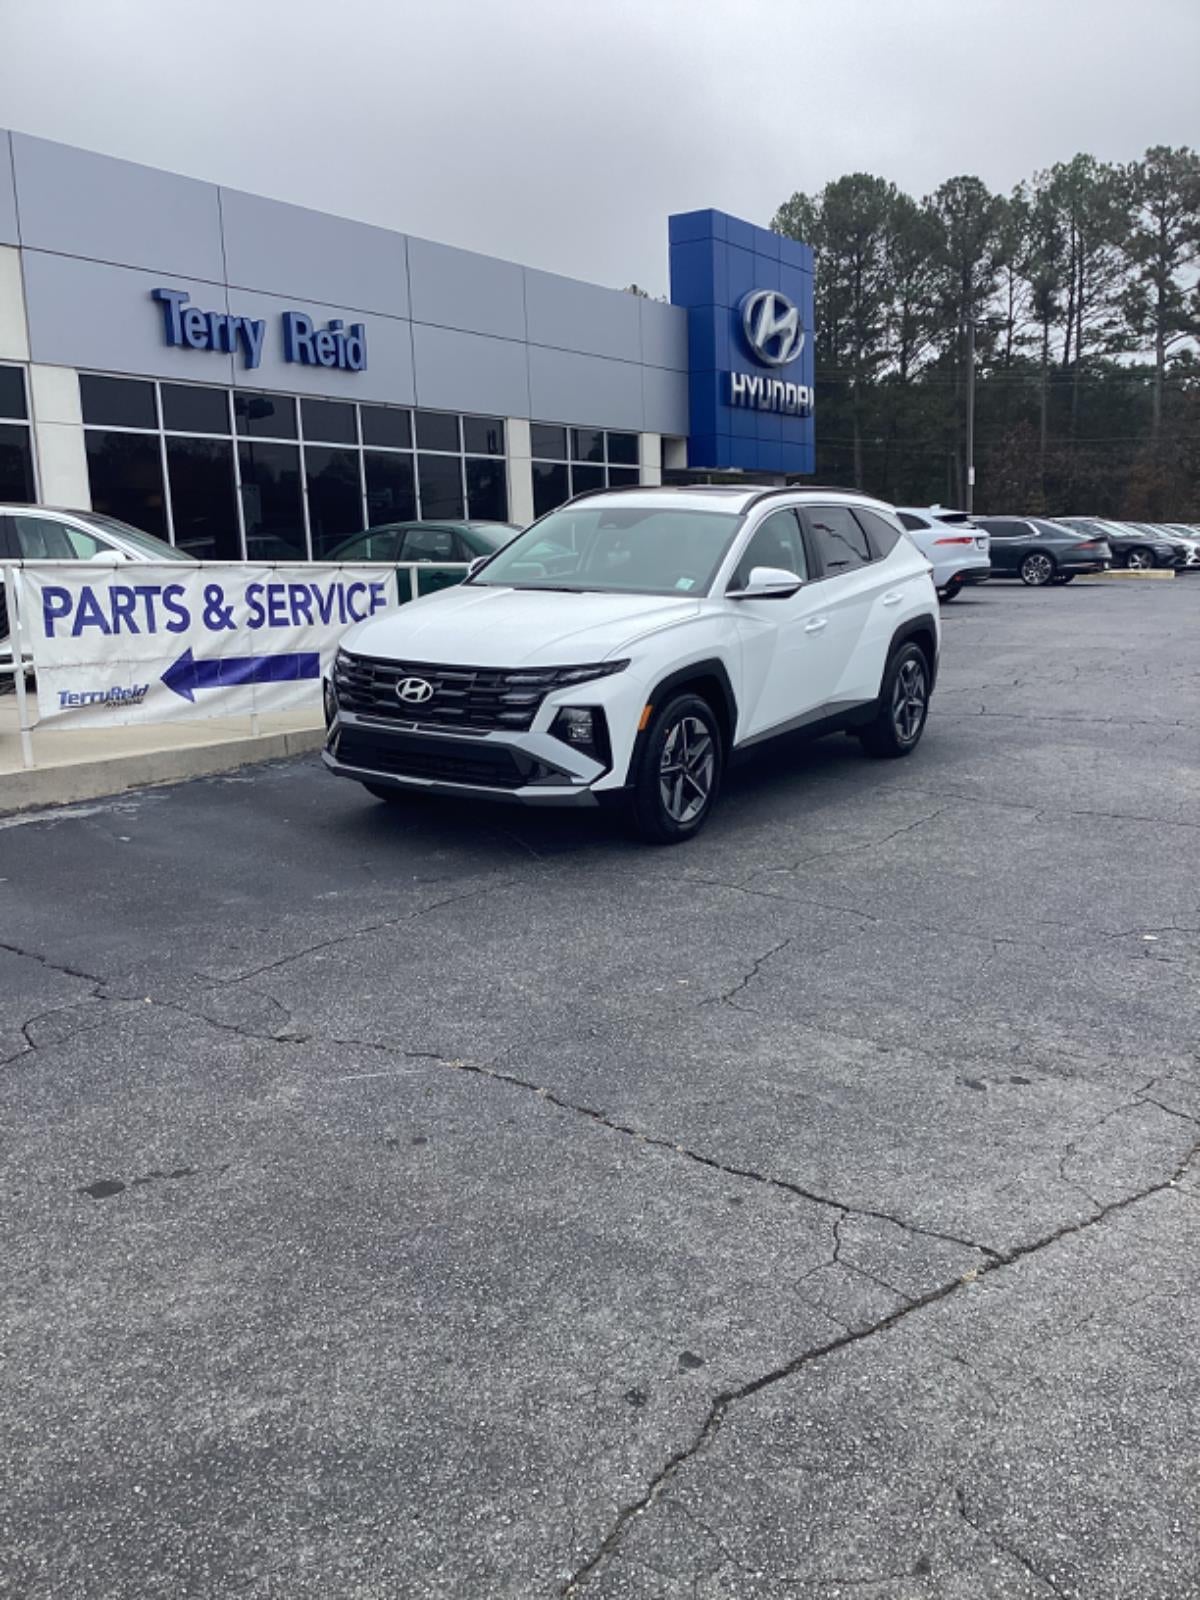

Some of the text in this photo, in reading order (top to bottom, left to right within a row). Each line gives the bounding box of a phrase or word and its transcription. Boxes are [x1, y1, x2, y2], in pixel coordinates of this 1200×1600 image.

[152, 288, 367, 371] Terry Reid
[730, 372, 815, 416] HYUNDAI
[41, 582, 387, 638] PARTS & SERVICE
